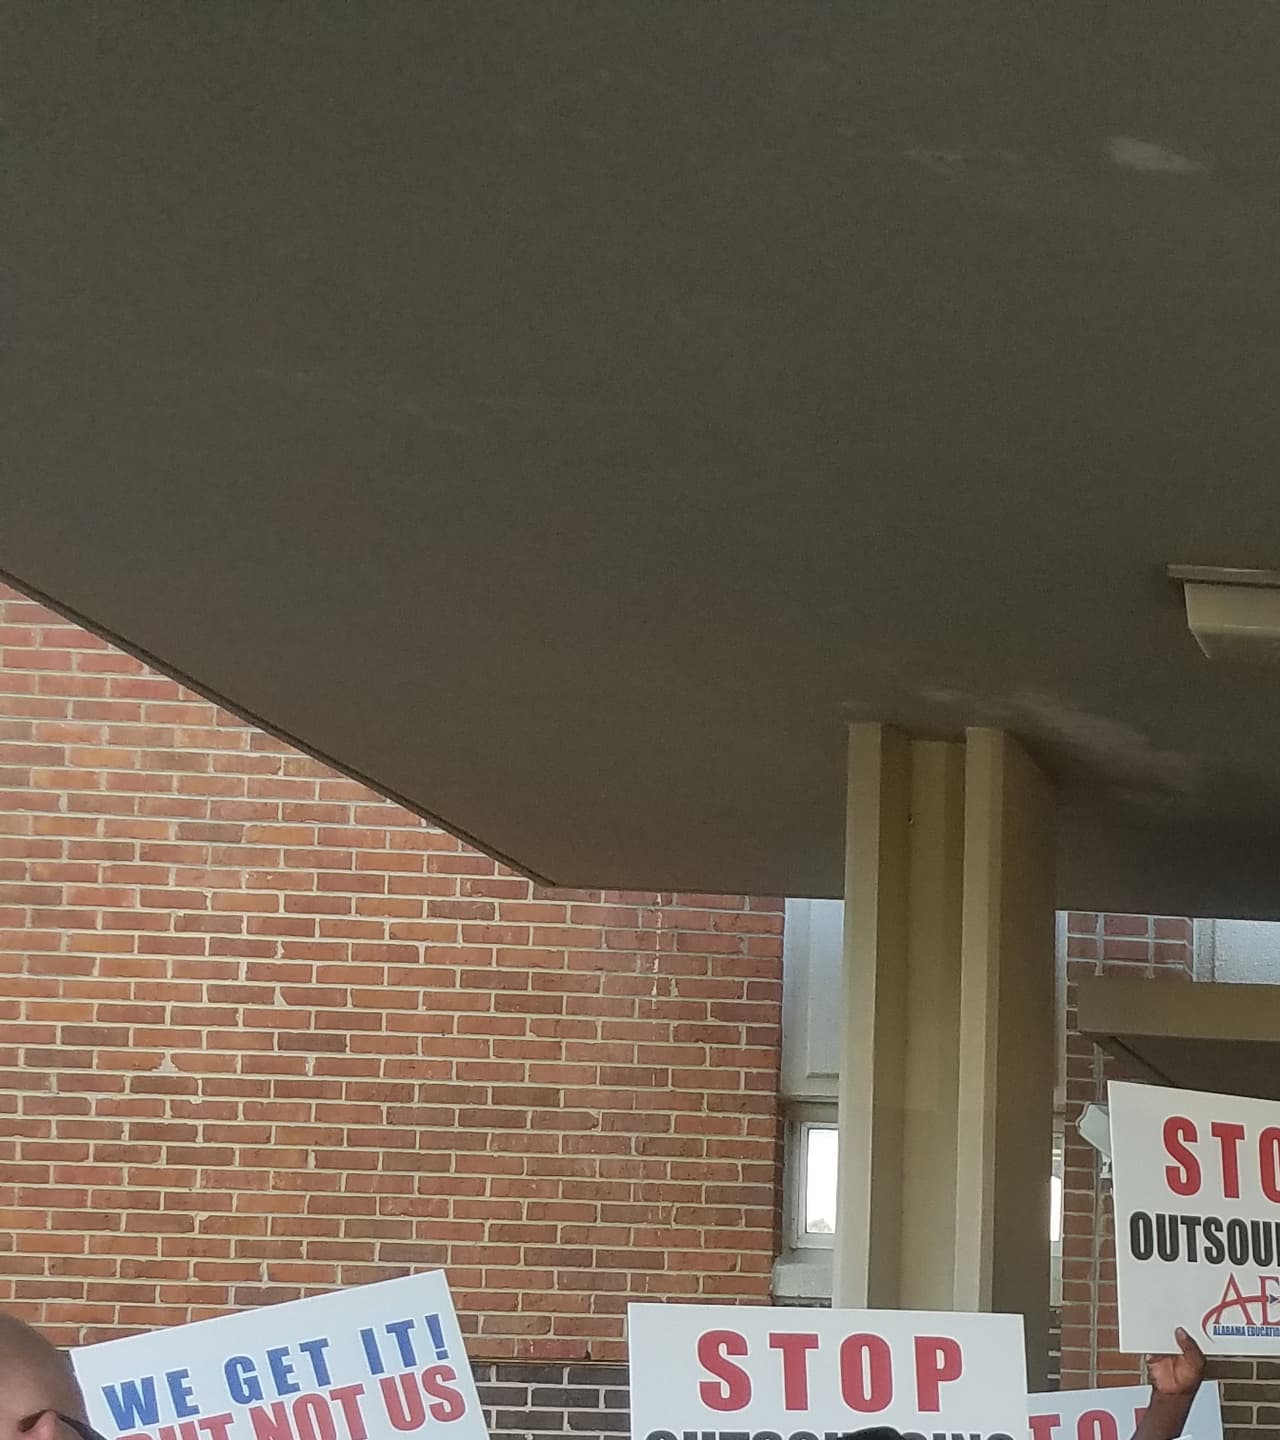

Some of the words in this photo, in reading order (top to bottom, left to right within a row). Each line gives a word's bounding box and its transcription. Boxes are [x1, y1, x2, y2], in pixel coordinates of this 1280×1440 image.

[1213, 1325, 1246, 1337] ALABAMA
[101, 1368, 201, 1431] WE
[223, 1337, 332, 1405] GET
[359, 1313, 449, 1375] IT!
[379, 1364, 467, 1431] US
[697, 1329, 963, 1413] STOP
